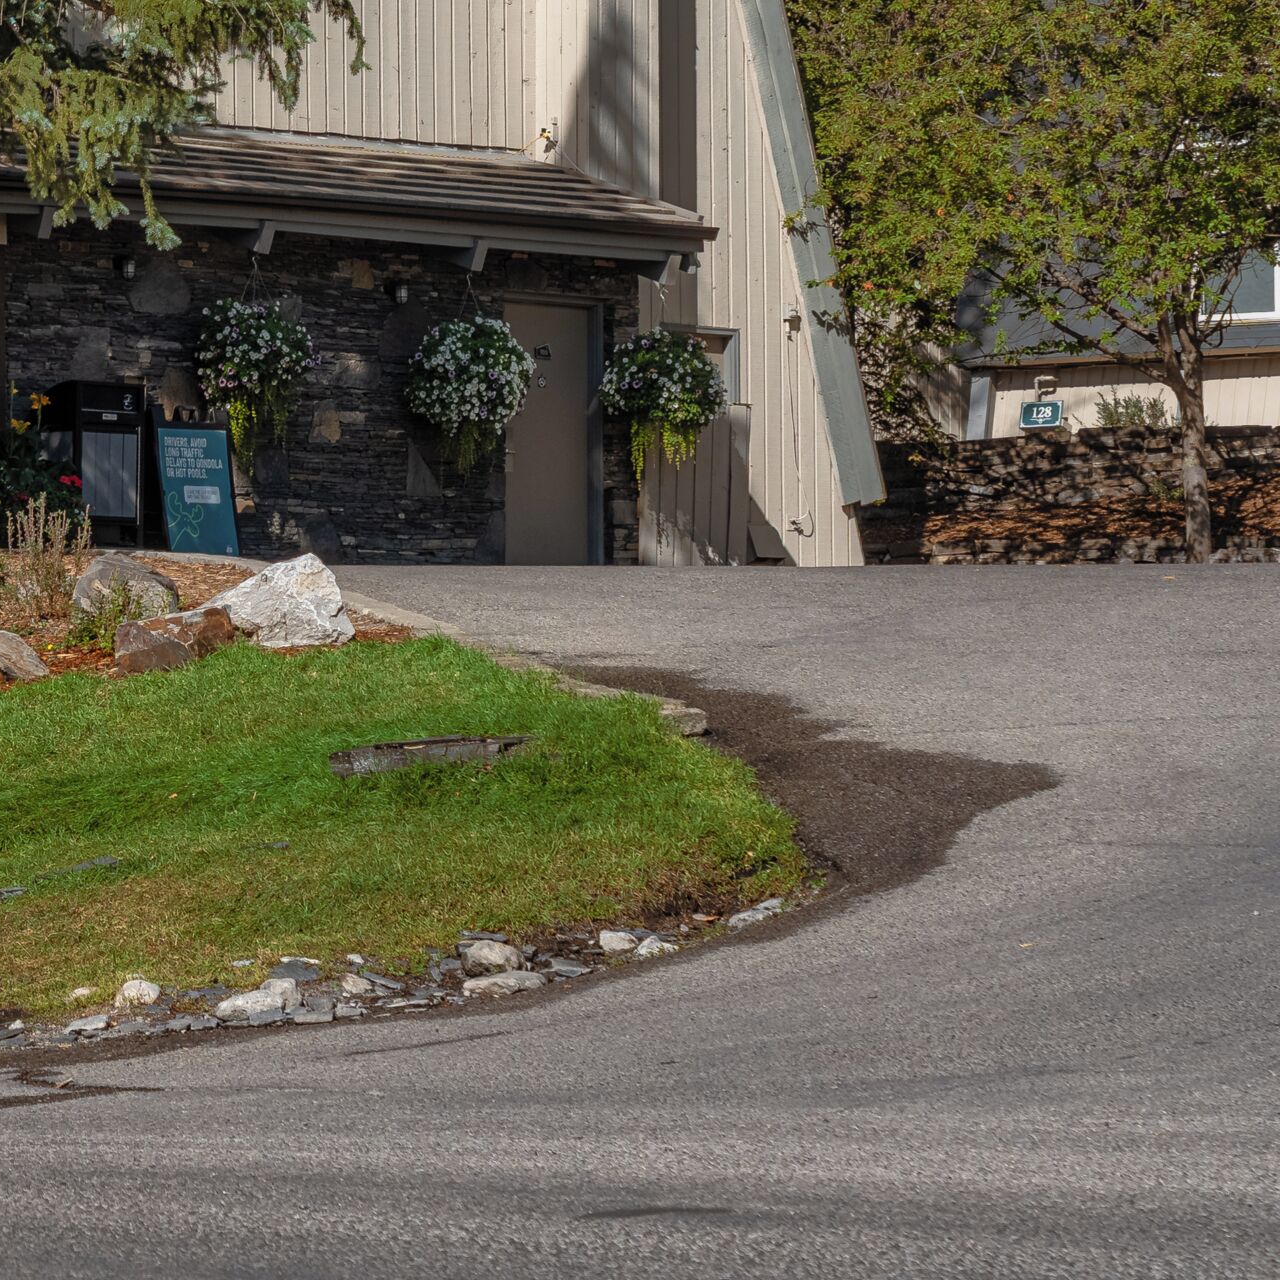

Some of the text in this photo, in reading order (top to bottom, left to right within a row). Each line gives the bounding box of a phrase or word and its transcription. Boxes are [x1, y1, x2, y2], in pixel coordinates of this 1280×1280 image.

[1032, 406, 1052, 418] 128
[190, 437, 207, 448] AVOID
[164, 447, 204, 458] LONG TRAFFIC
[165, 457, 223, 469] DELAYS TO GONDOLA
[166, 467, 175, 478] OR
[175, 468, 188, 478] HOT
